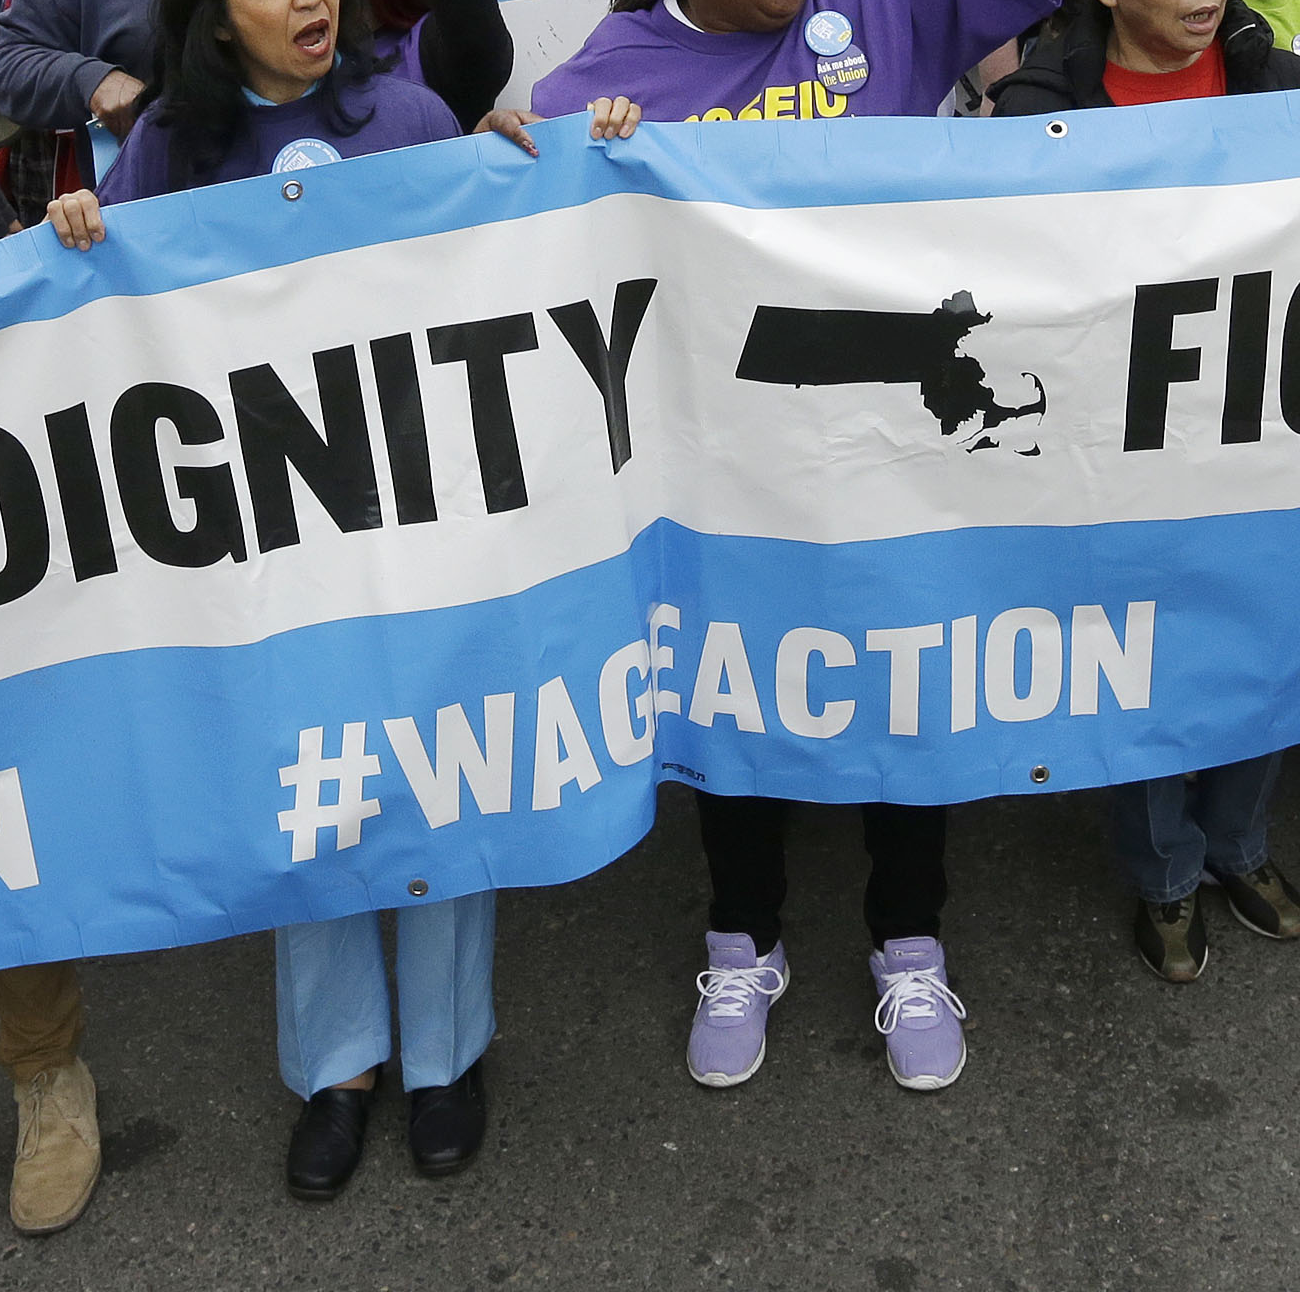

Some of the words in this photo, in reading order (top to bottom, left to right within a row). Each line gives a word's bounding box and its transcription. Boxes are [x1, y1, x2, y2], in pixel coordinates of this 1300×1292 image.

[816, 61, 832, 74] Ask
[831, 60, 844, 71] me
[843, 53, 867, 68] about
[823, 74, 838, 87] the
[837, 67, 868, 83] Union
[277, 600, 1156, 862] #WAGEACTION
